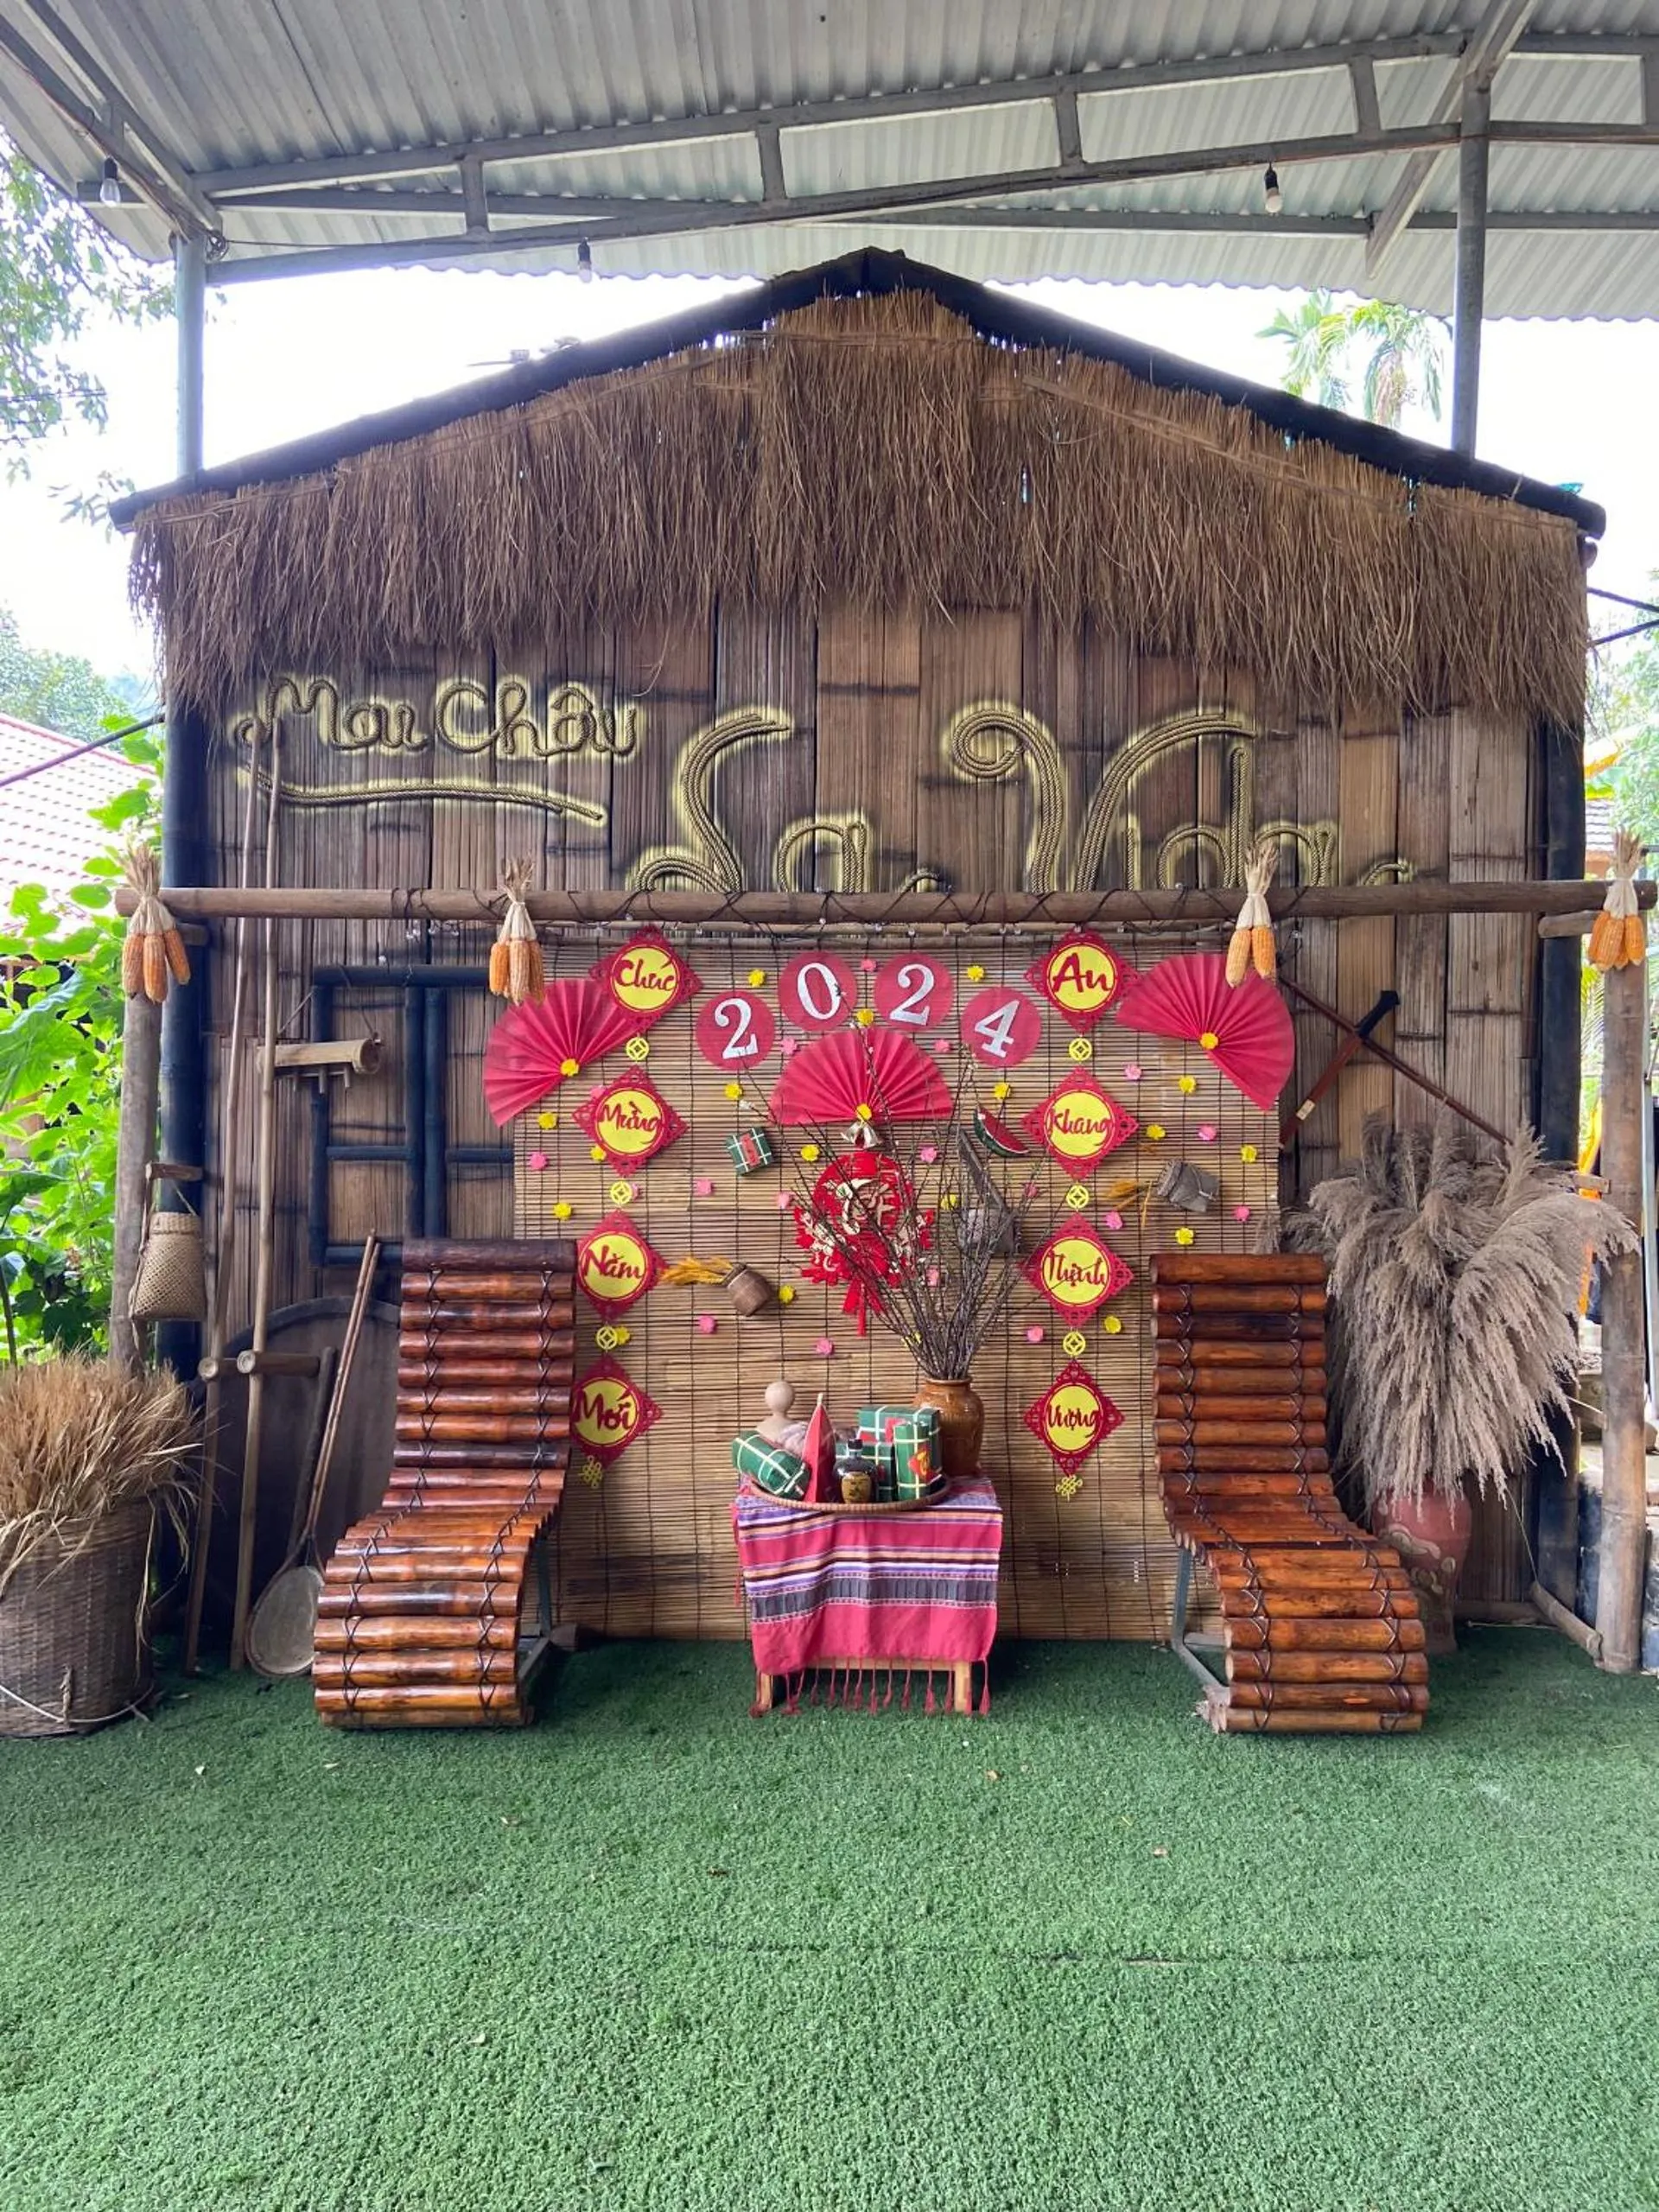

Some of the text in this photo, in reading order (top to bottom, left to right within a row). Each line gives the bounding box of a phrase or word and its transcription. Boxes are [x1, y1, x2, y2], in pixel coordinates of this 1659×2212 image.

[436, 679, 638, 756] Châu
[615, 957, 677, 992] Chúc
[1052, 951, 1112, 993] An
[714, 962, 1020, 1060] 2024
[597, 1100, 660, 1145] Mừng
[1046, 1108, 1112, 1147] Khang
[582, 1243, 644, 1279] Năm
[1046, 1250, 1106, 1287] Thịnh
[572, 1388, 634, 1431] Mới
[1047, 1403, 1100, 1439] Vượng
